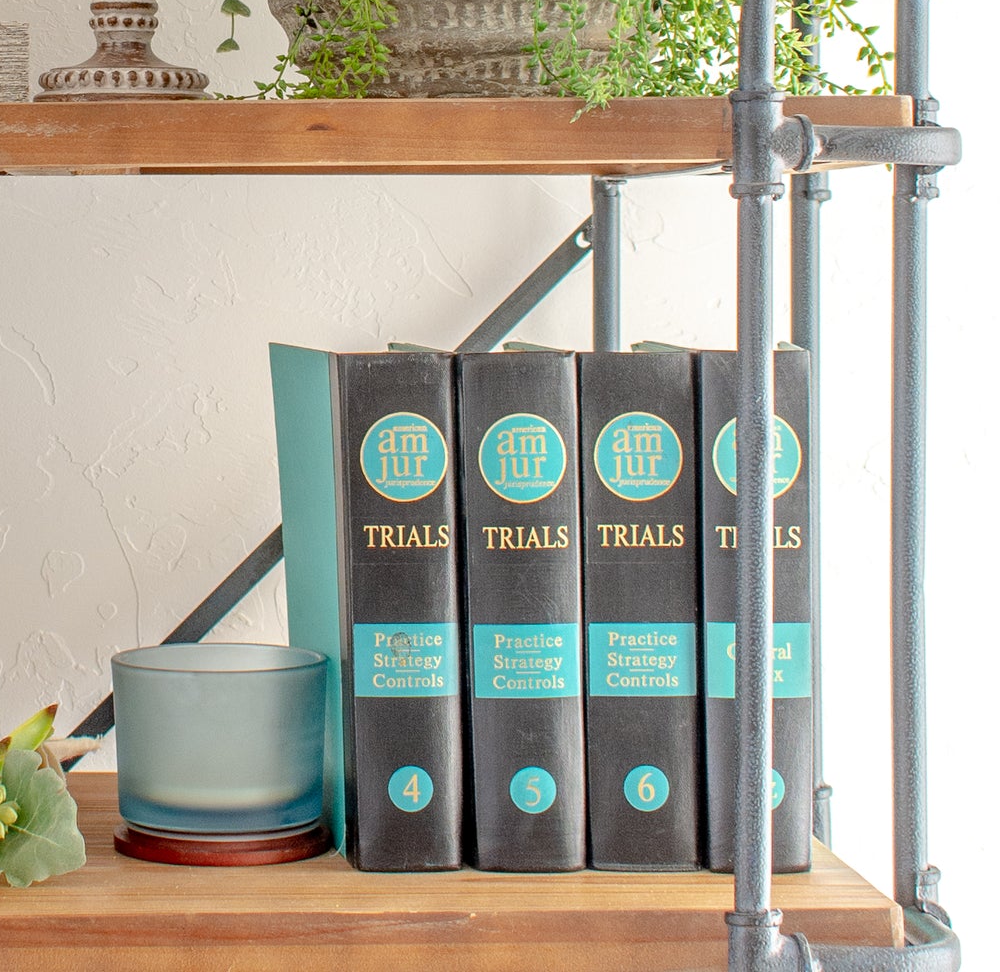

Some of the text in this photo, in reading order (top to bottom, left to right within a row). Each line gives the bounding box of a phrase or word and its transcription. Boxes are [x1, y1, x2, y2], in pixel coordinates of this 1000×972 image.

[378, 429, 429, 454] am
[497, 430, 548, 455] am
[612, 428, 663, 453] am
[376, 455, 428, 484] jur
[495, 456, 547, 485] jur
[610, 454, 662, 483] jur
[363, 524, 450, 548] TRIALS
[482, 525, 569, 550] TRIALS
[597, 524, 685, 548] TRIALS
[374, 632, 443, 647] Practice
[494, 633, 563, 648] Practice
[607, 631, 677, 647] Practice
[373, 653, 442, 670] Strategy
[493, 654, 563, 671] Strategy
[607, 652, 677, 669] Strategy
[372, 673, 444, 688] Controls
[492, 675, 565, 690] Controls
[606, 673, 679, 688] Controls
[402, 773, 421, 803] 4
[525, 776, 541, 806] 5
[637, 772, 655, 802] 6
